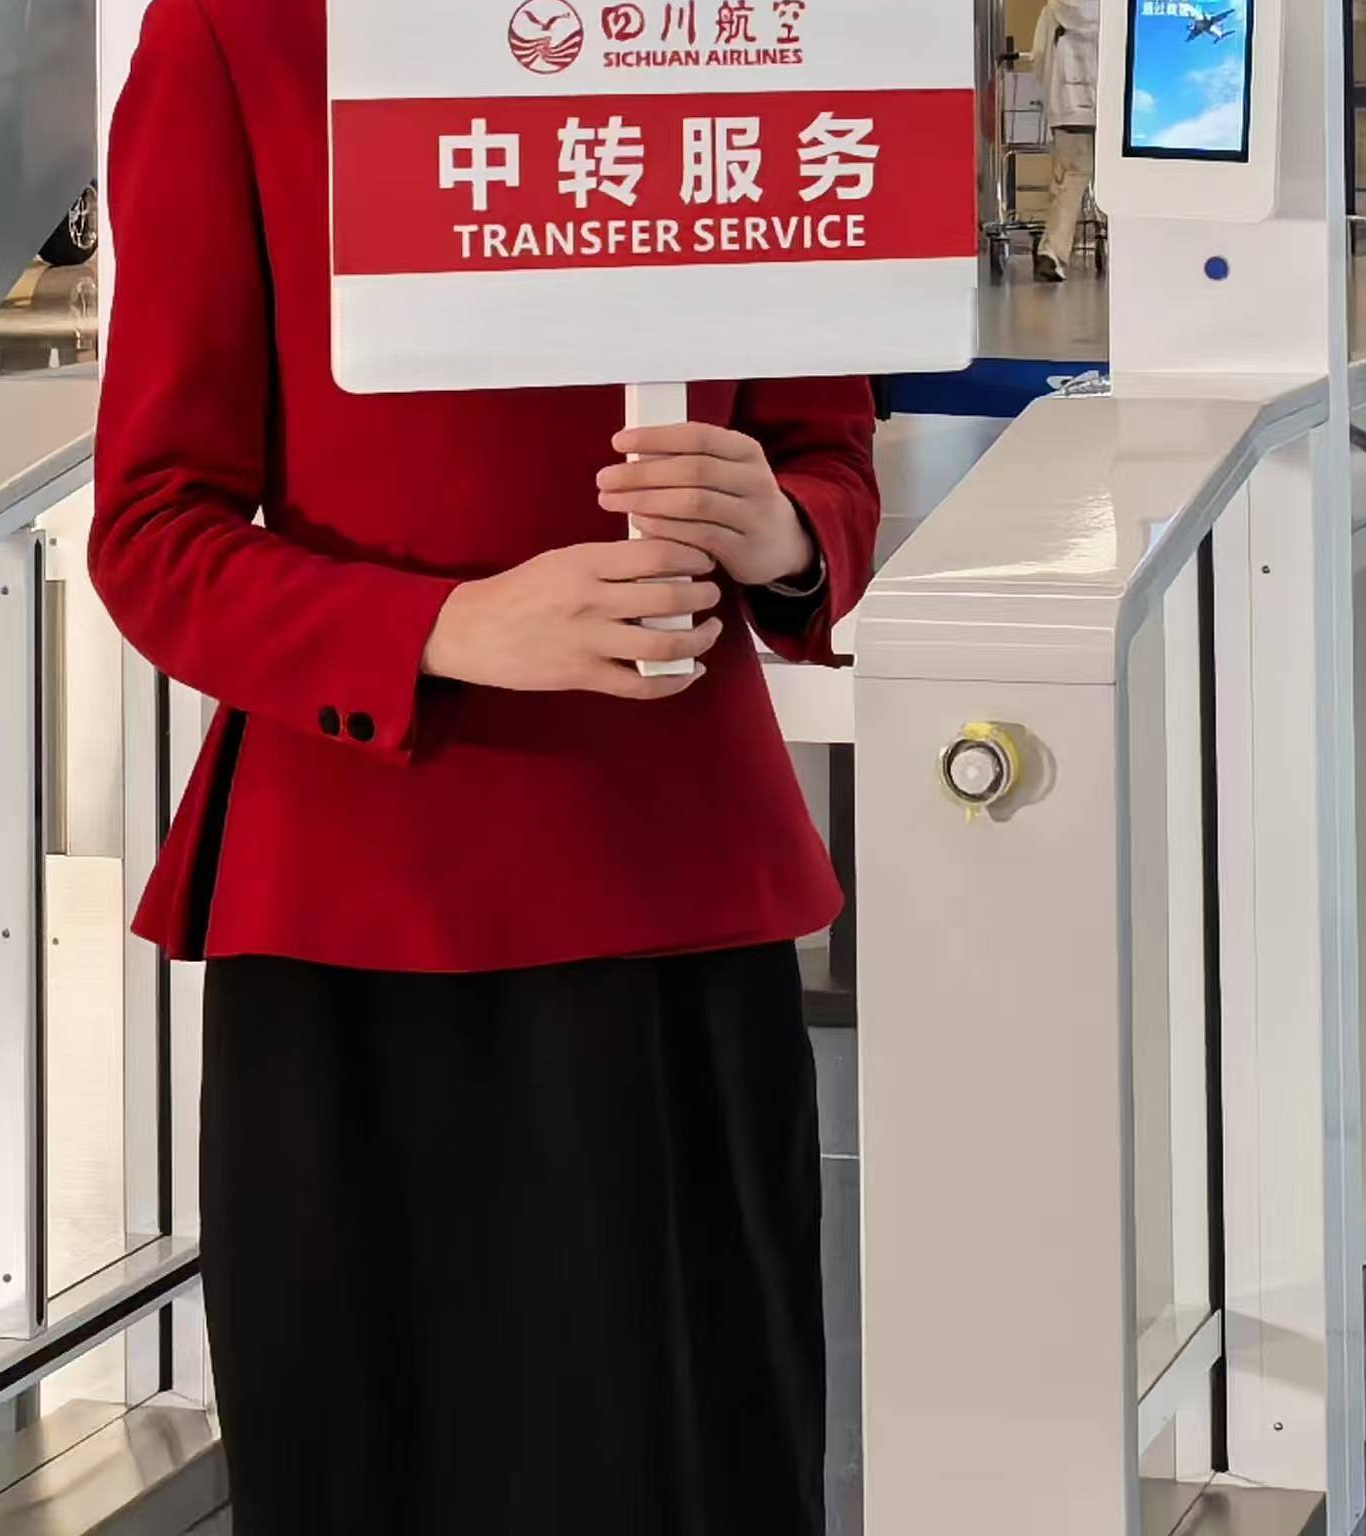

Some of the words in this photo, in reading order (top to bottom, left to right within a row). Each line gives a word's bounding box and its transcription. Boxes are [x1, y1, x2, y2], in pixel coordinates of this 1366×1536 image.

[602, 49, 701, 69] SICHUAN
[705, 46, 804, 66] AIRLINES
[437, 110, 881, 212] 中转服务
[453, 216, 683, 259] TRANSFER
[694, 213, 867, 256] SERVICE
